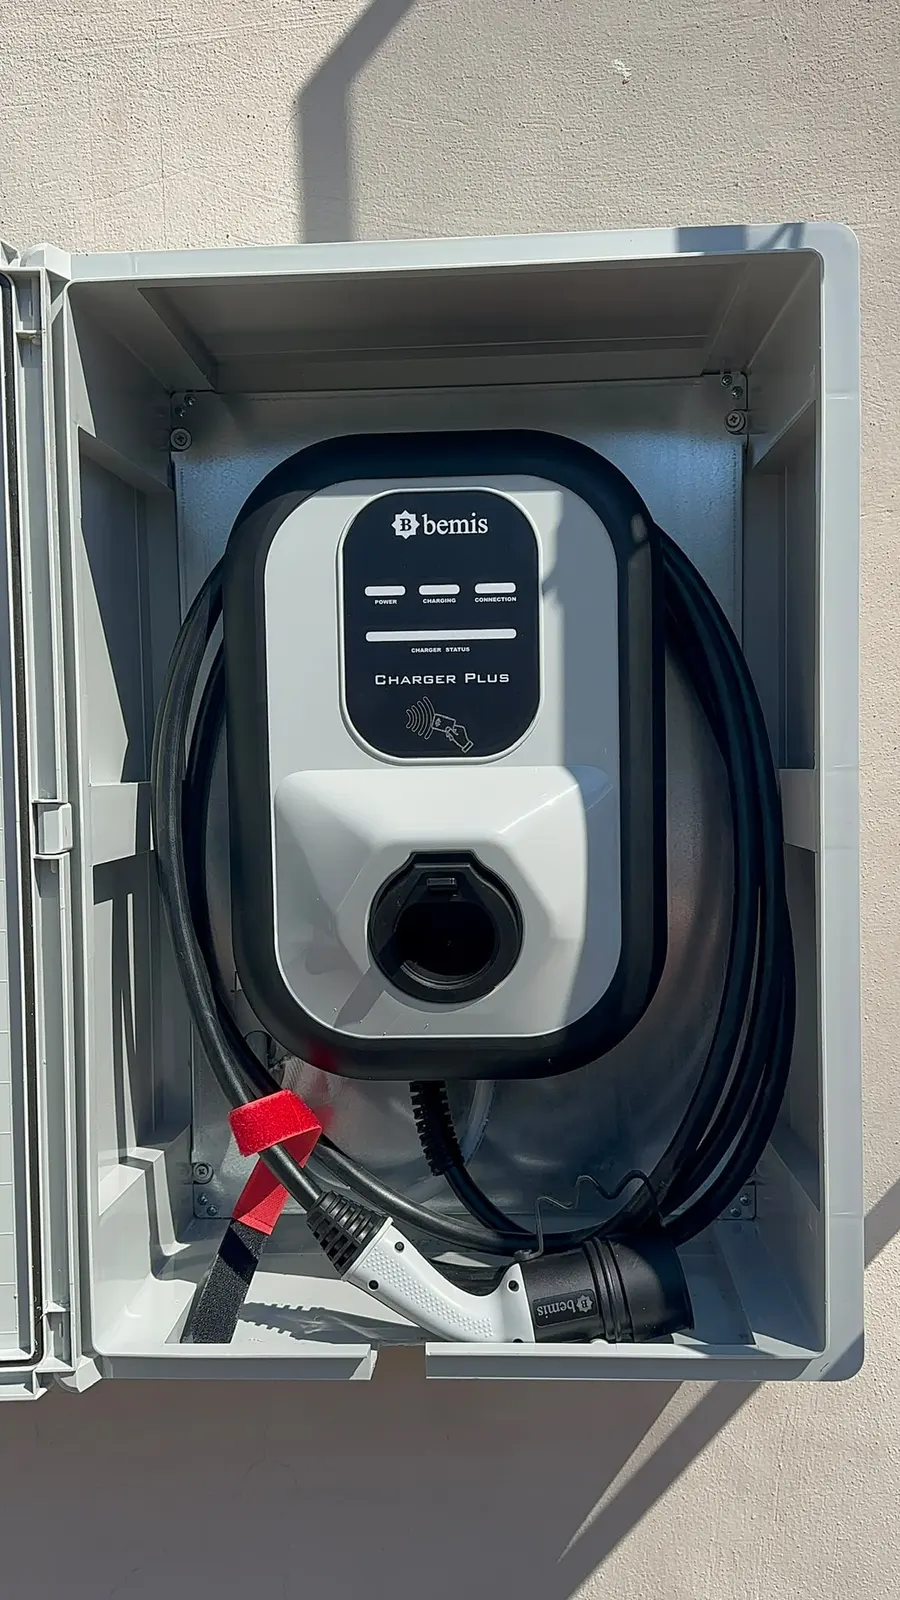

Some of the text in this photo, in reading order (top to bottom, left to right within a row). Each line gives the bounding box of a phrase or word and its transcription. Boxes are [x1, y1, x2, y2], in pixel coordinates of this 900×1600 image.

[399, 513, 489, 535] B bemis
[374, 672, 510, 685] CHARGER PLUS
[536, 1299, 576, 1319] bemis
